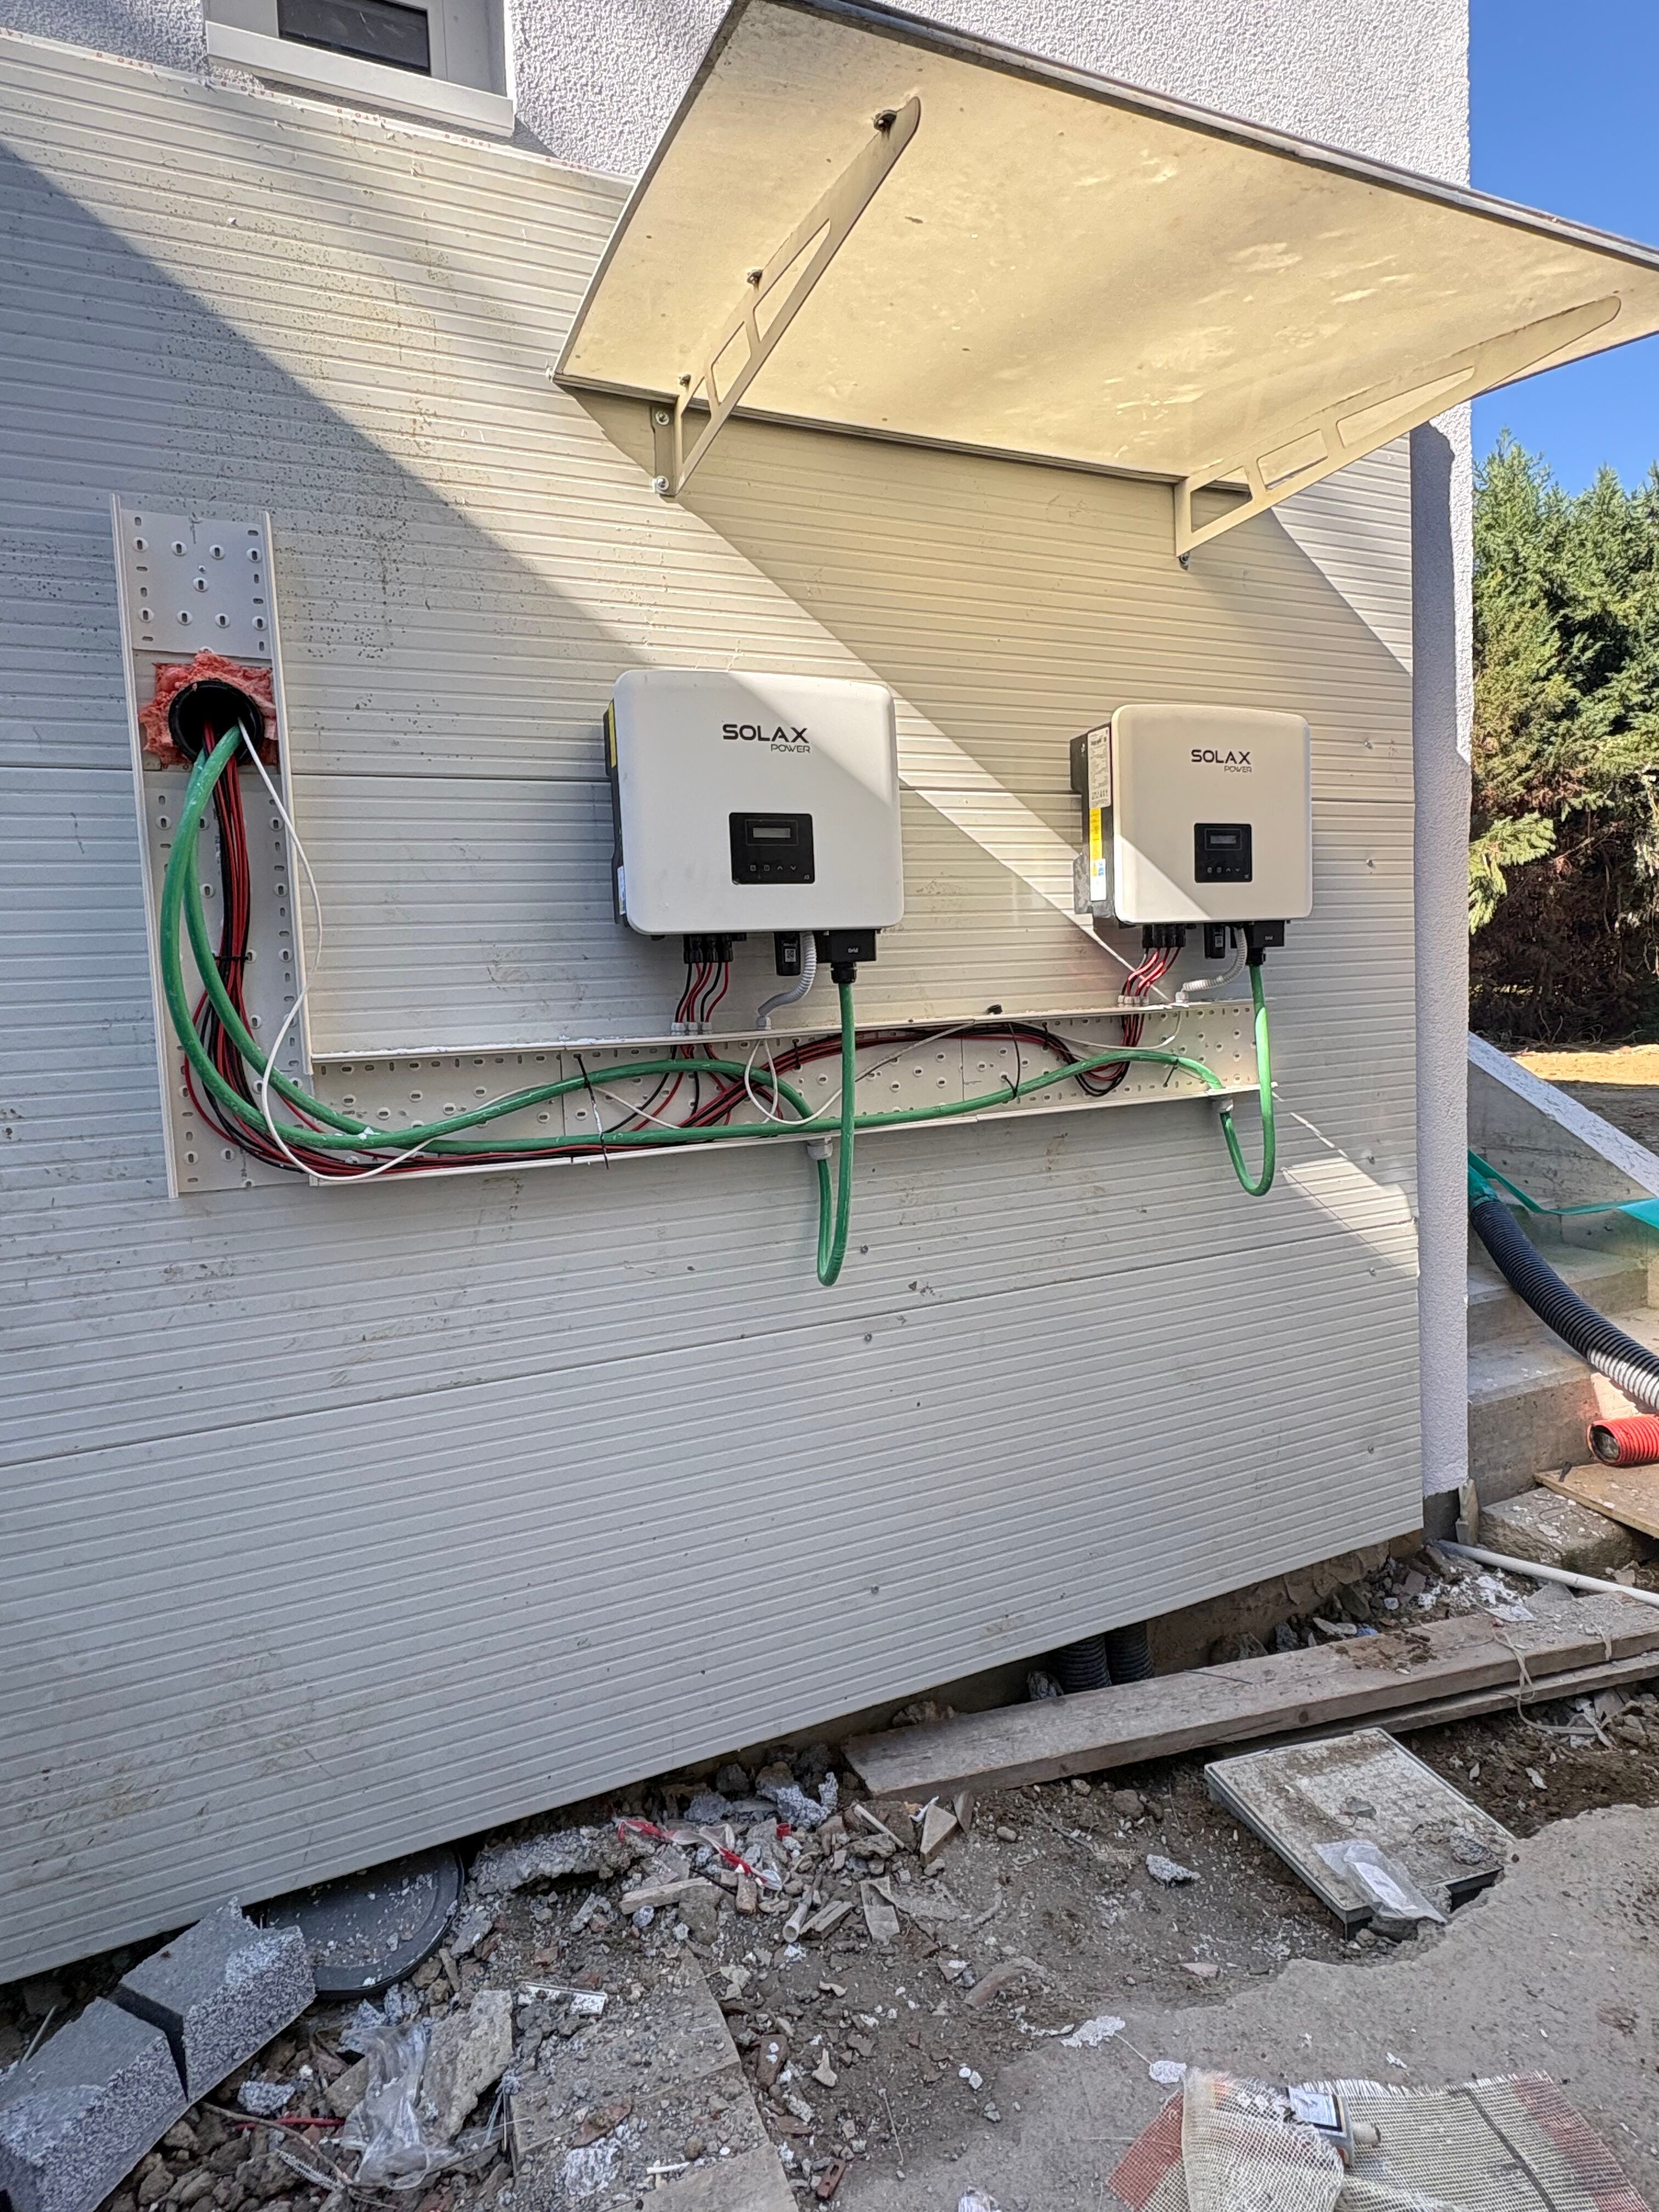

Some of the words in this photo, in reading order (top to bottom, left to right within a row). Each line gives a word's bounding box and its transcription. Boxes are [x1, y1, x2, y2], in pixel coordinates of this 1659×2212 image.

[722, 724, 809, 743] SOLAX
[770, 743, 811, 754] POWER
[1190, 749, 1251, 765] SOLAX
[1223, 765, 1252, 773] POWER
